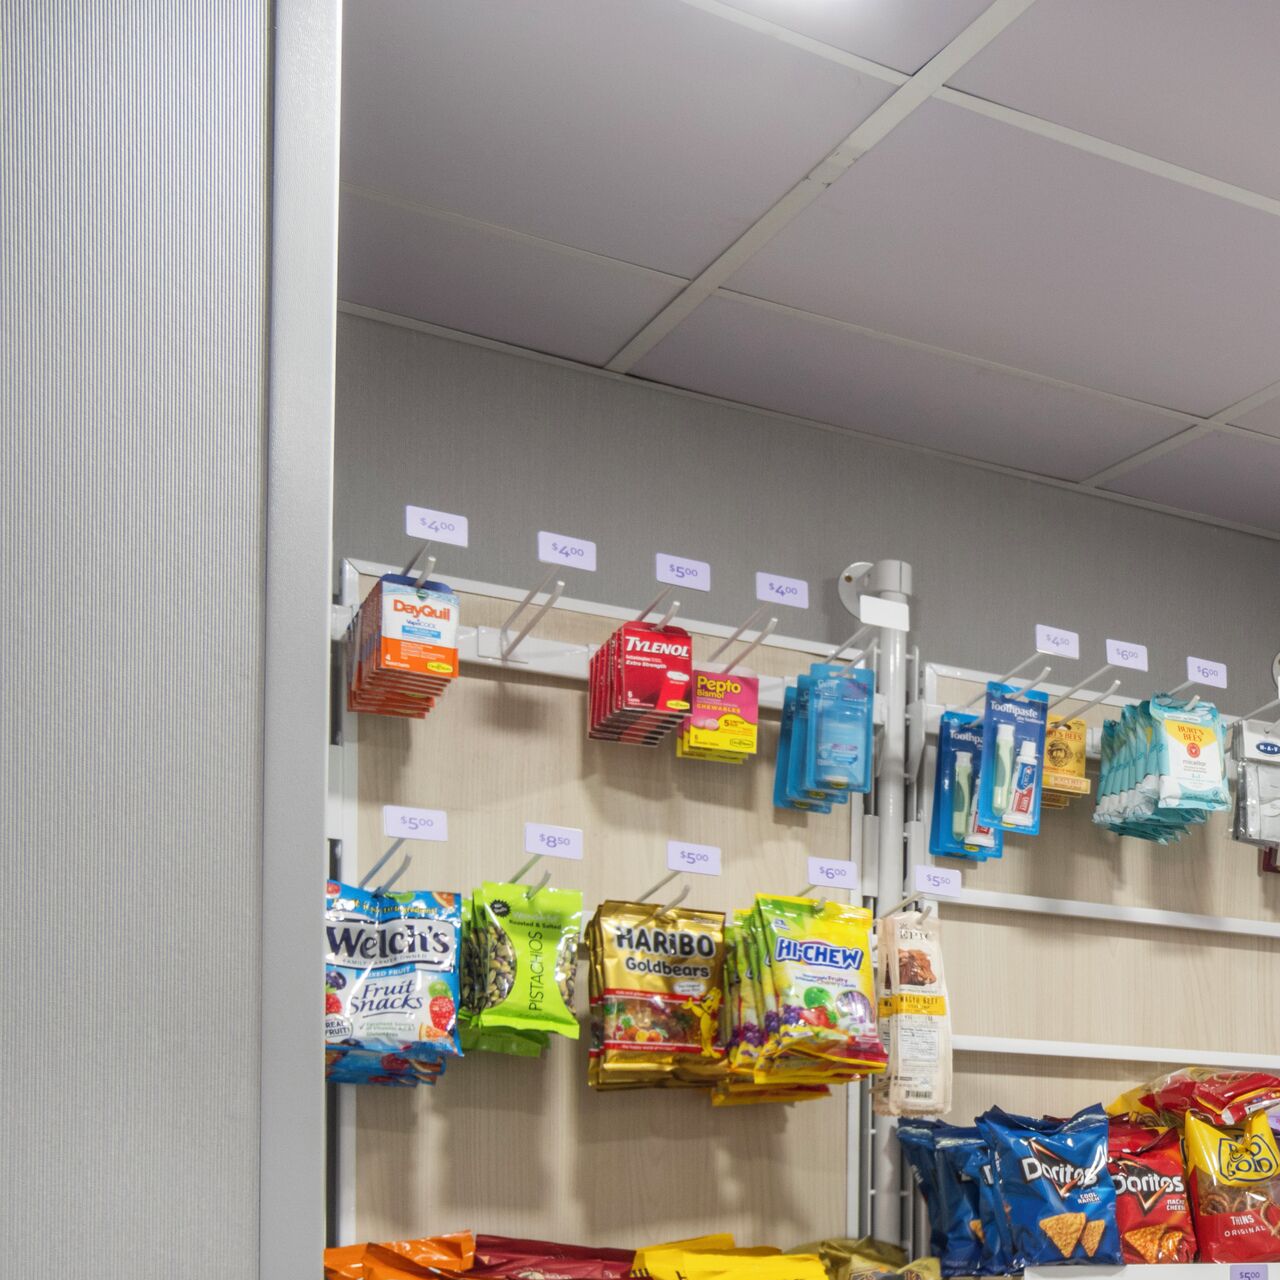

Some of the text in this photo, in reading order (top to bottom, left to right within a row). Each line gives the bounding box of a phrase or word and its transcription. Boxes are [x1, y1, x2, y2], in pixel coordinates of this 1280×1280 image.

[393, 599, 451, 622] DayQuil
[625, 636, 690, 657] TYLENOL
[696, 689, 725, 699] Bismol
[697, 675, 742, 695] Pepto
[990, 700, 1039, 719] Toothpaste
[1183, 733, 1203, 742] BEES
[326, 924, 450, 960] Welch's
[615, 925, 715, 958] HARIBO
[775, 936, 863, 970] HI-CHEW
[527, 931, 545, 1012] PISTACHIOS
[624, 956, 711, 979] Goldbears
[362, 979, 416, 1000] Fruit
[350, 994, 423, 1015] Snacks
[325, 1021, 345, 1029] REAL
[1021, 1156, 1099, 1187] Doritos
[1115, 1172, 1185, 1196] Doritos
[1224, 1225, 1266, 1238] ORIGINAL
